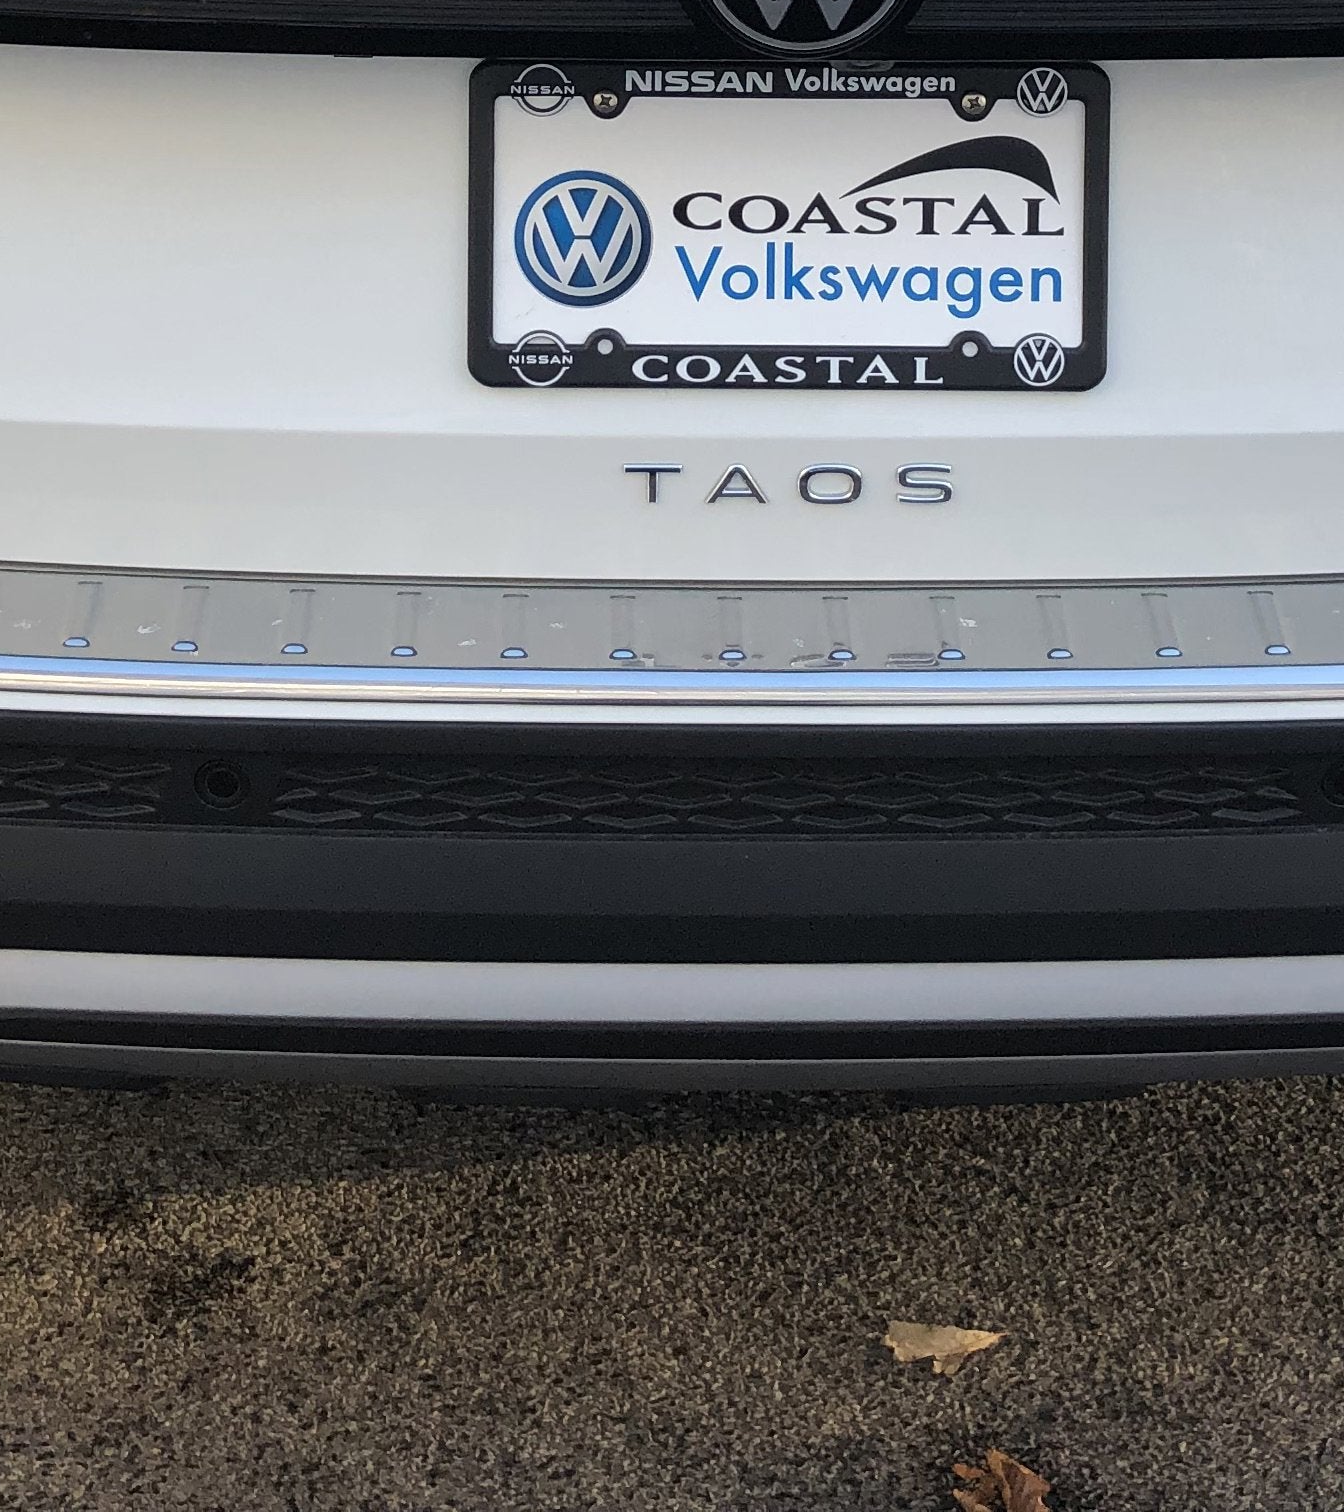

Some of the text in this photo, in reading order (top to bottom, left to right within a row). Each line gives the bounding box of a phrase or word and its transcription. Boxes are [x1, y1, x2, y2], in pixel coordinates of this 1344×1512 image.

[510, 84, 575, 95] NISSAN
[624, 67, 956, 98] NISSAN Volkswagen
[672, 192, 1065, 237] COASTAL
[674, 241, 1063, 319] Volkswagen
[508, 354, 574, 365] NISSAN
[631, 353, 944, 385] COASTAL
[623, 462, 954, 504] TAOS
